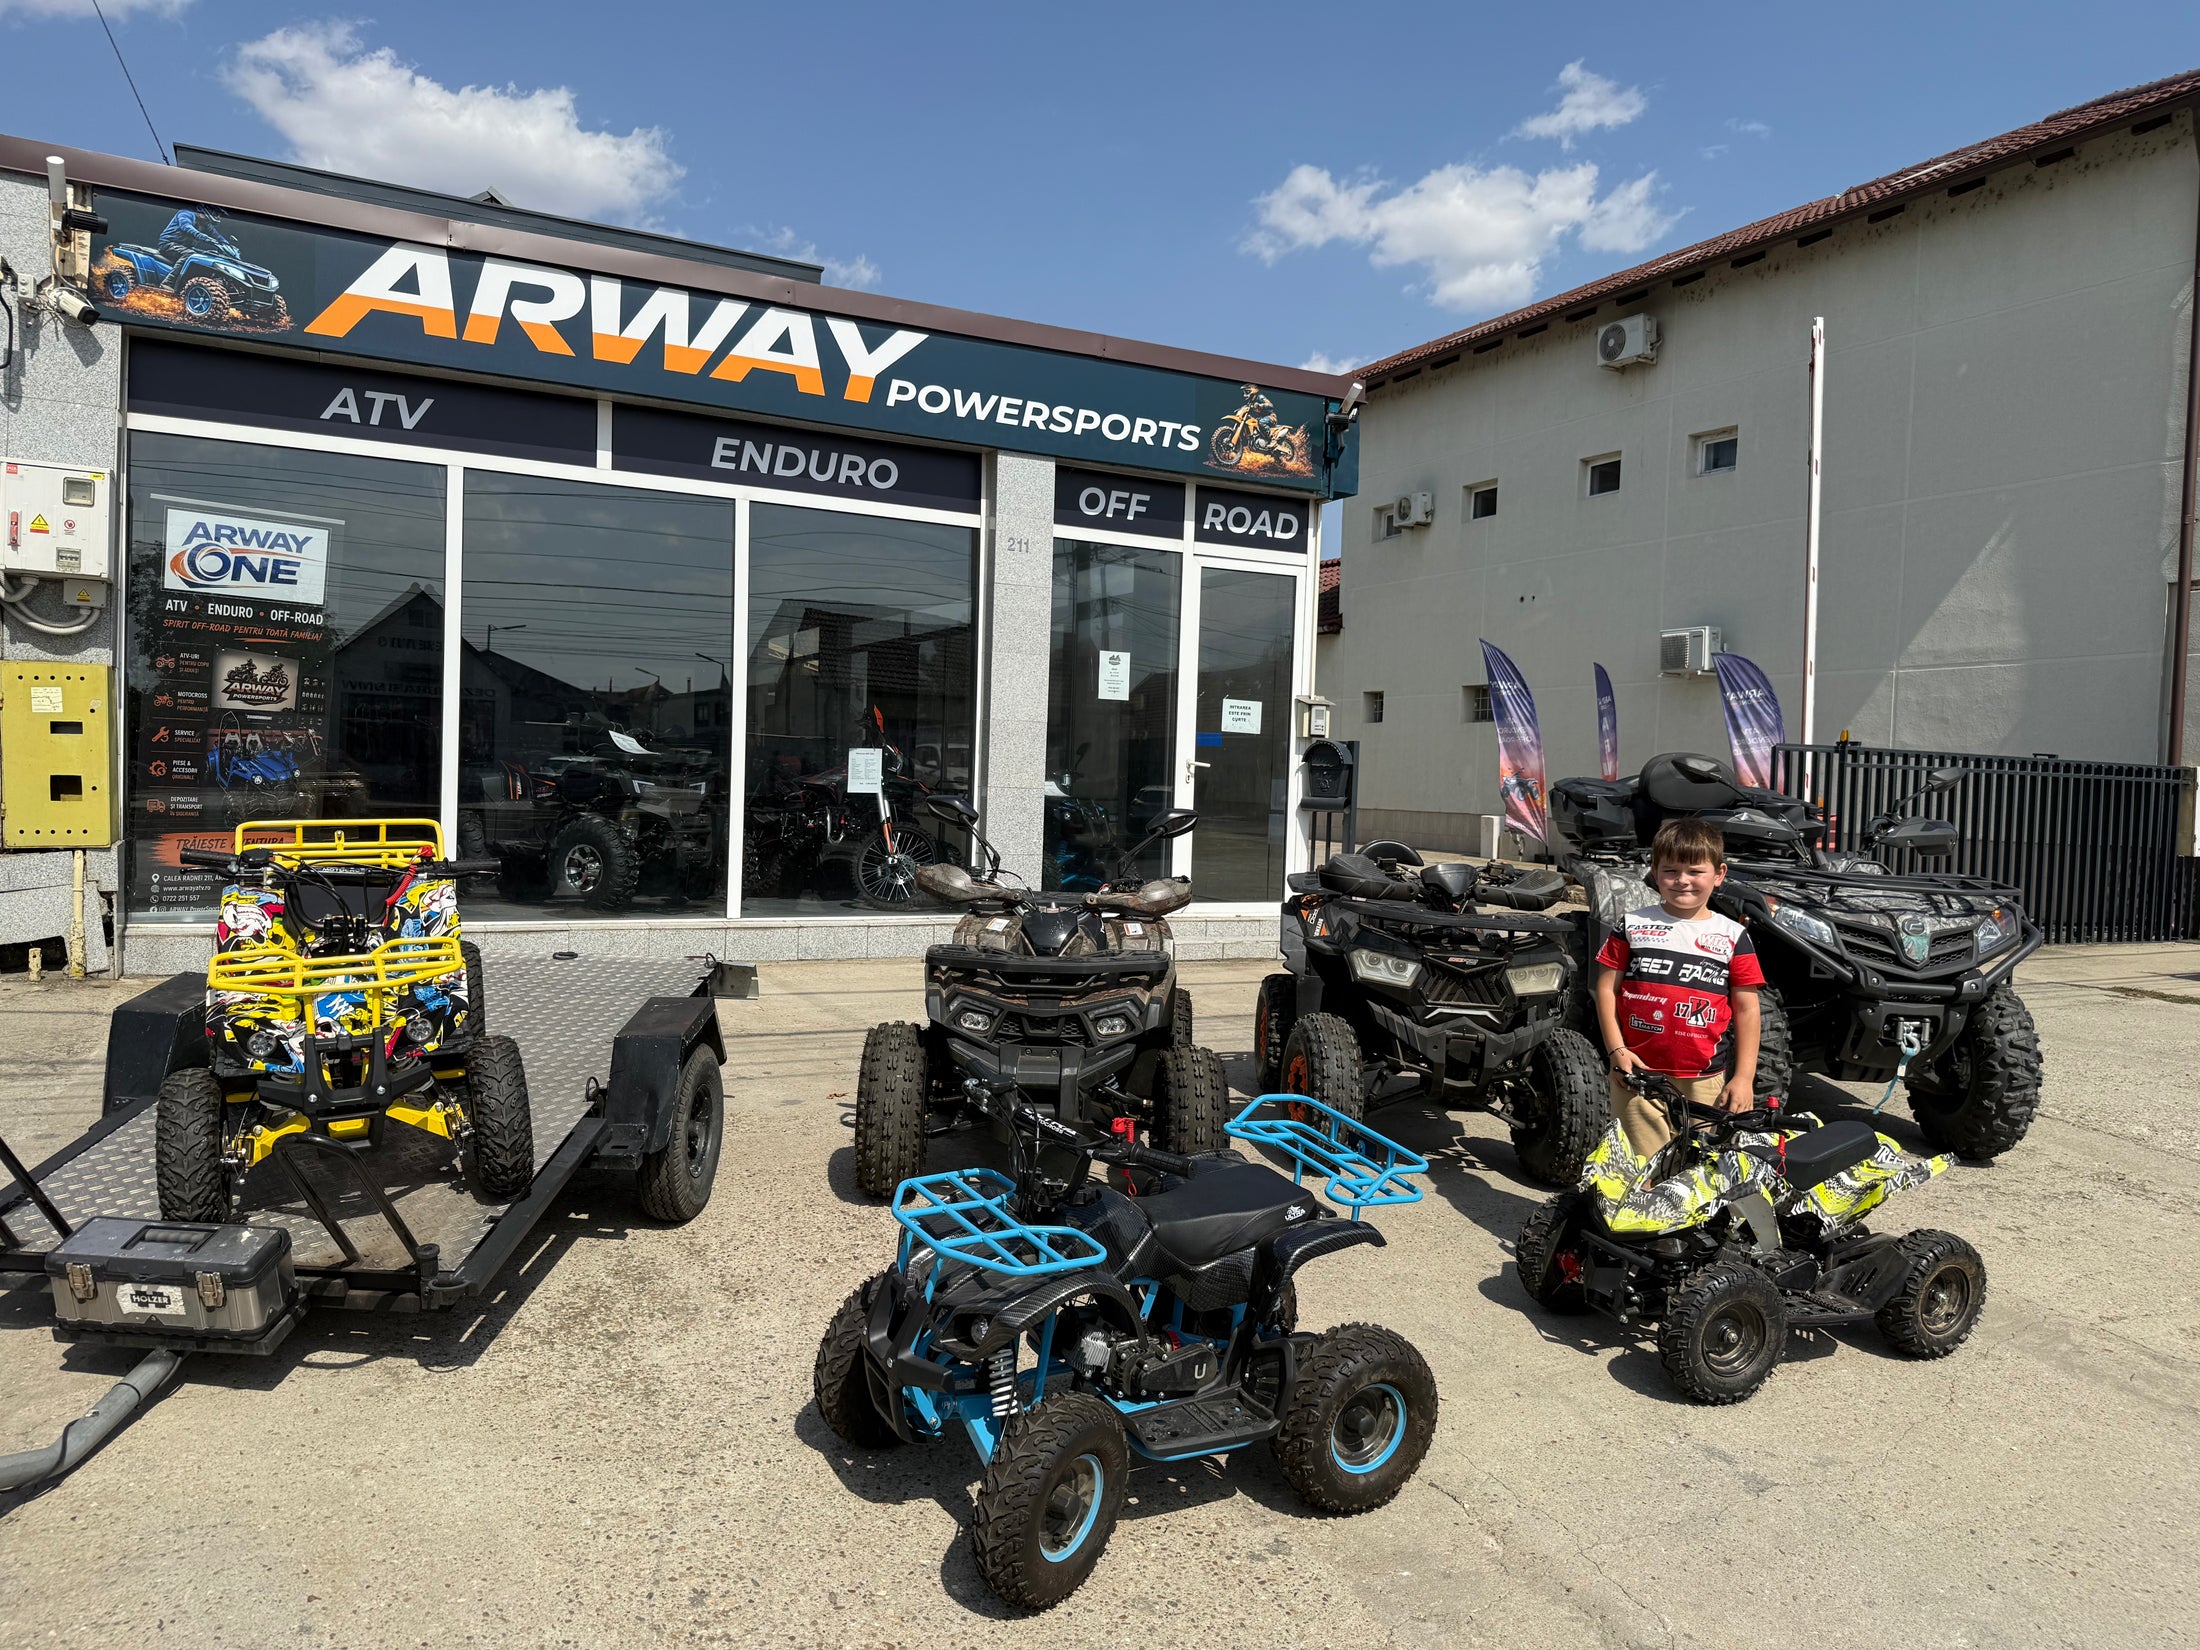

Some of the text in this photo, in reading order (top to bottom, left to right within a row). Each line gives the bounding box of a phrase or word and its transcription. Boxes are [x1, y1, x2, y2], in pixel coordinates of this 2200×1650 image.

[303, 241, 928, 403] ARWAY
[320, 387, 434, 430] ATV
[886, 378, 1201, 452] POWERSPORTS
[711, 437, 899, 490] ENDURO
[1078, 487, 1151, 521] OFF
[1203, 502, 1299, 540] ROAD
[181, 521, 313, 553] ARWAY
[1007, 537, 1029, 553] 211
[187, 542, 301, 585] ONE
[165, 599, 324, 625] ATV ENDURO OFF-ROAD
[163, 619, 323, 642] SPIRIT OFF-ROAD PENTRU TOATĂ FAMILIA!
[179, 652, 200, 660] ATV-URI
[177, 691, 208, 699] MOTOCROSS
[227, 683, 286, 697] ARWAY
[232, 693, 278, 701] POWERSPORTS
[174, 729, 195, 737] SERVICE
[1627, 924, 1674, 932] FASTER
[1674, 996, 1717, 1029] 17 K 11
[1028, 1114, 1064, 1134] MTOCROSS
[132, 1295, 169, 1304] HOLZER
[1195, 1363, 1206, 1379] U
